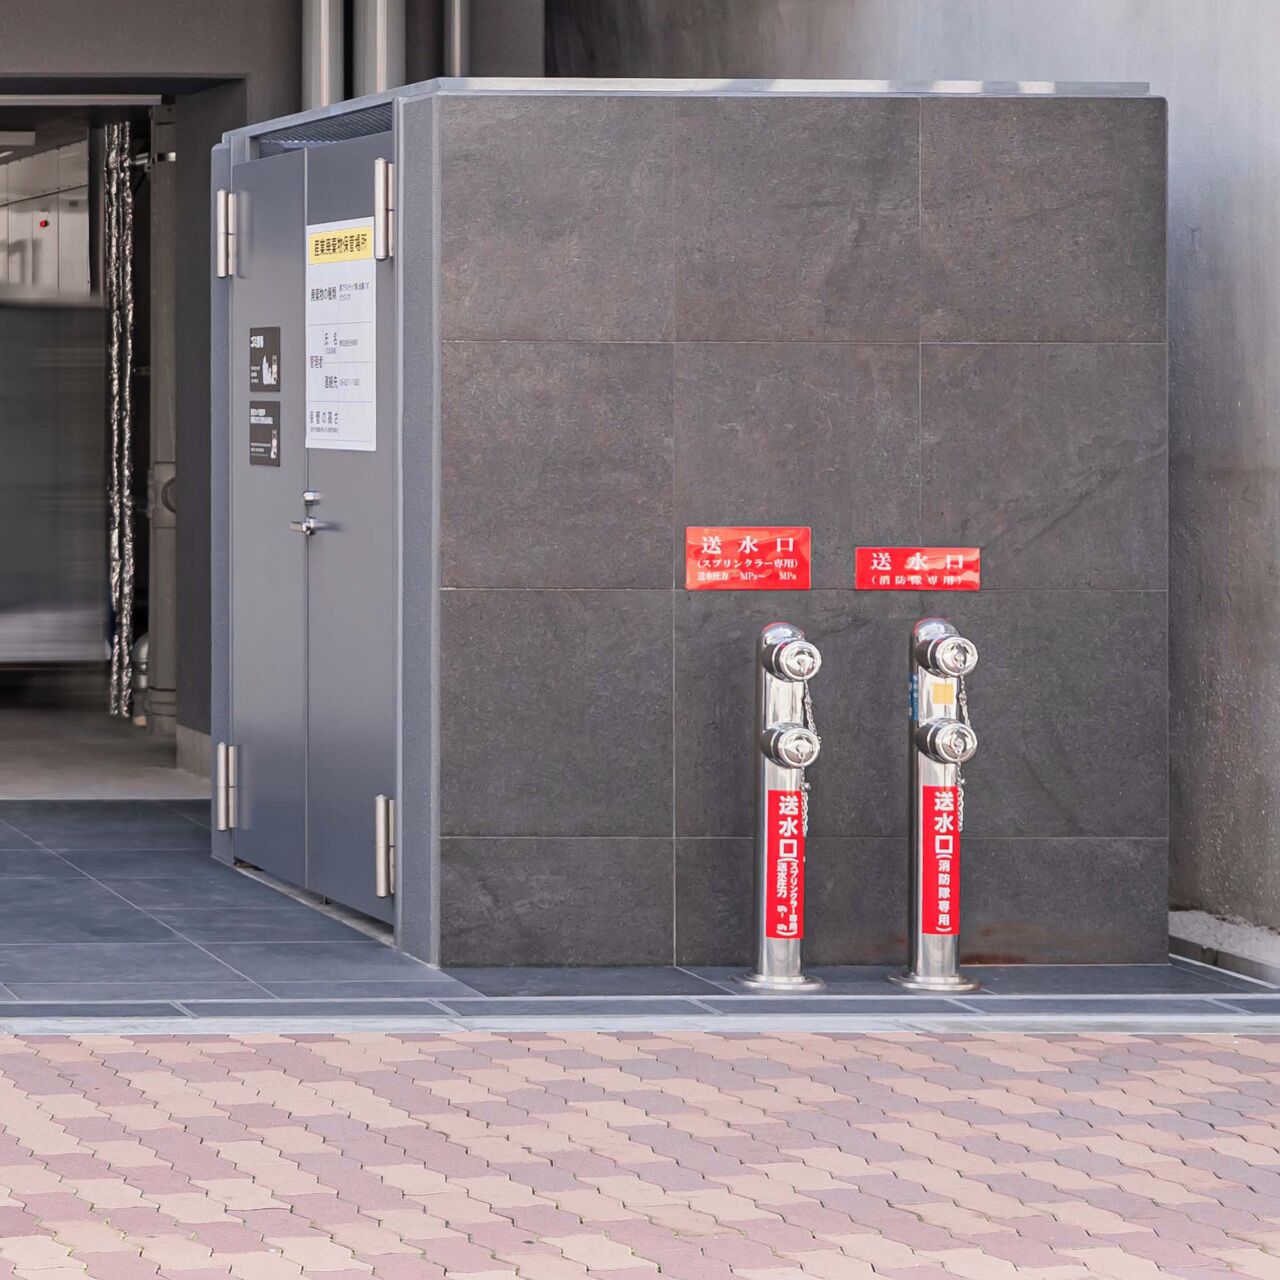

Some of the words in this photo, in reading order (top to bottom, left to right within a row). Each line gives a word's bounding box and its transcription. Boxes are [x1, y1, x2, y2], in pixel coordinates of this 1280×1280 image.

[701, 535, 794, 554] 送水口
[870, 552, 964, 570] 送水口
[778, 795, 799, 858] 送水口
